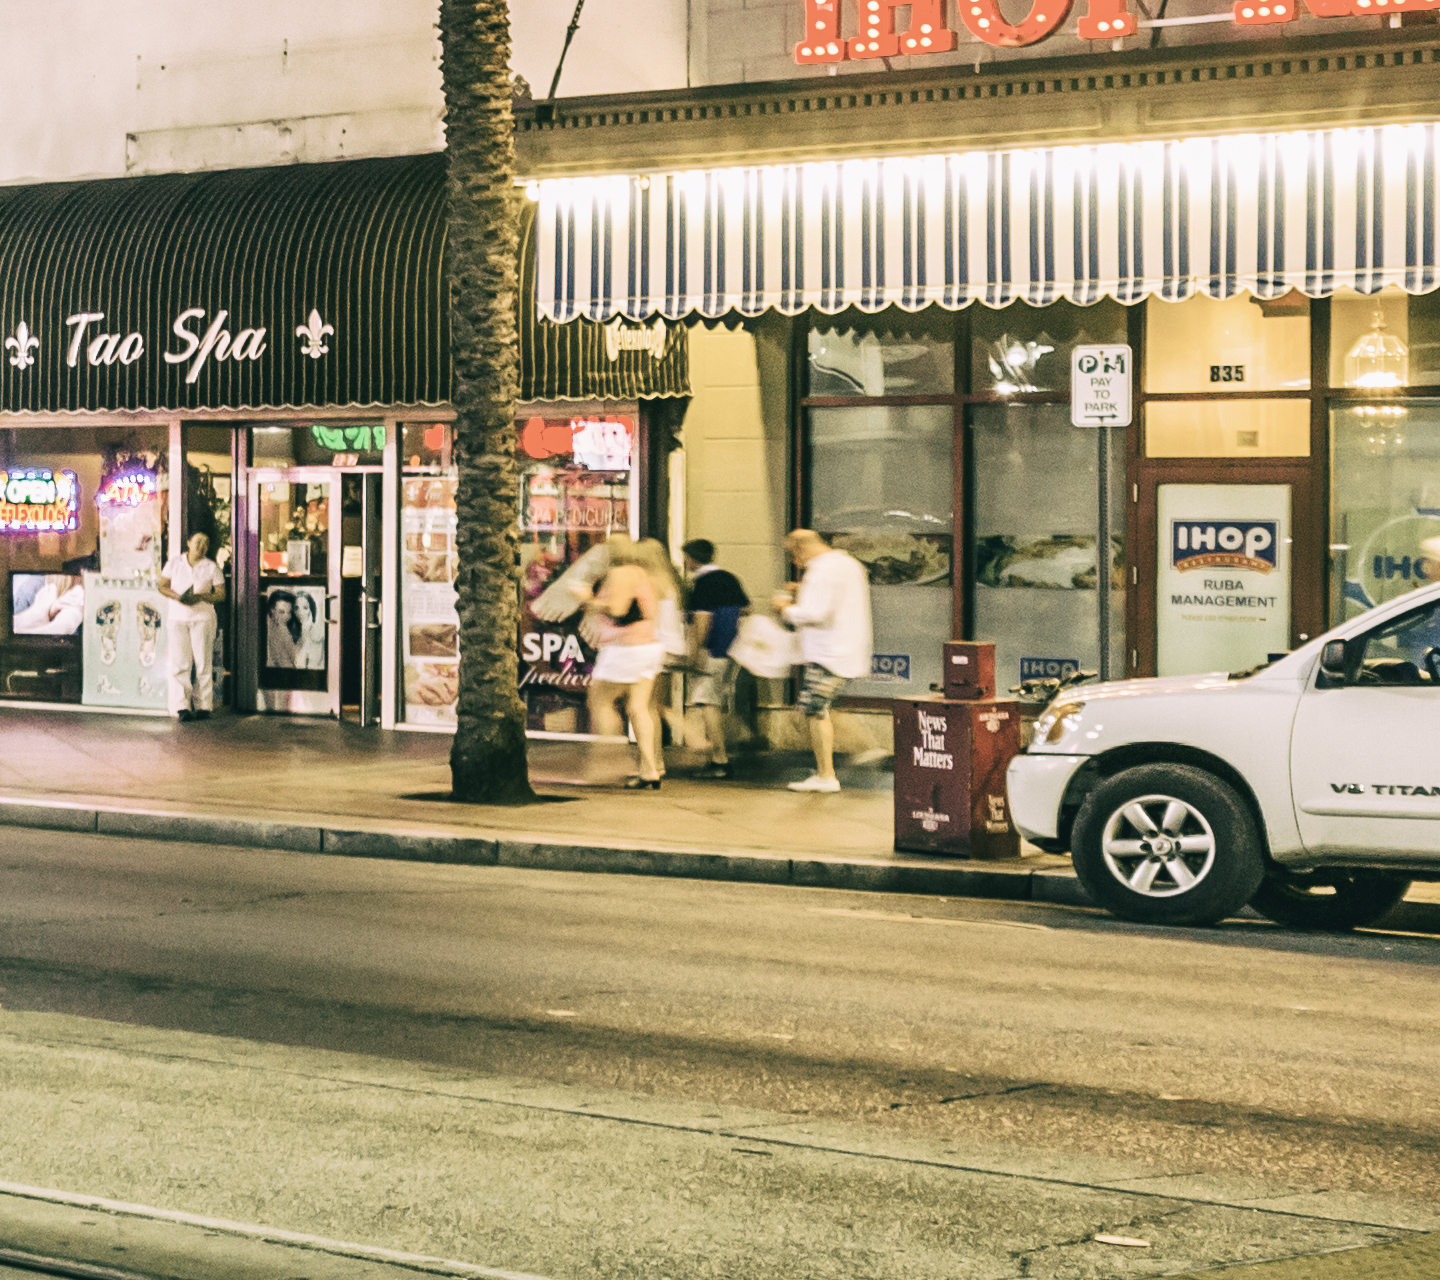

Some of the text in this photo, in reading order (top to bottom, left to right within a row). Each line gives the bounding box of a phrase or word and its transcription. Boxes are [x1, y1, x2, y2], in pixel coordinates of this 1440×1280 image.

[66, 307, 267, 384] Tao Spa
[1091, 377, 1112, 387] PAY
[1210, 365, 1244, 382] 835
[1093, 390, 1110, 400] TO
[1085, 402, 1118, 412] PARK
[1178, 526, 1272, 559] IHOP
[1204, 579, 1244, 590] RUBA
[1171, 595, 1277, 608] MANAGEMENT
[522, 632, 585, 663] SPA
[918, 710, 947, 732] News
[921, 729, 945, 751] That
[913, 746, 954, 770] Matters
